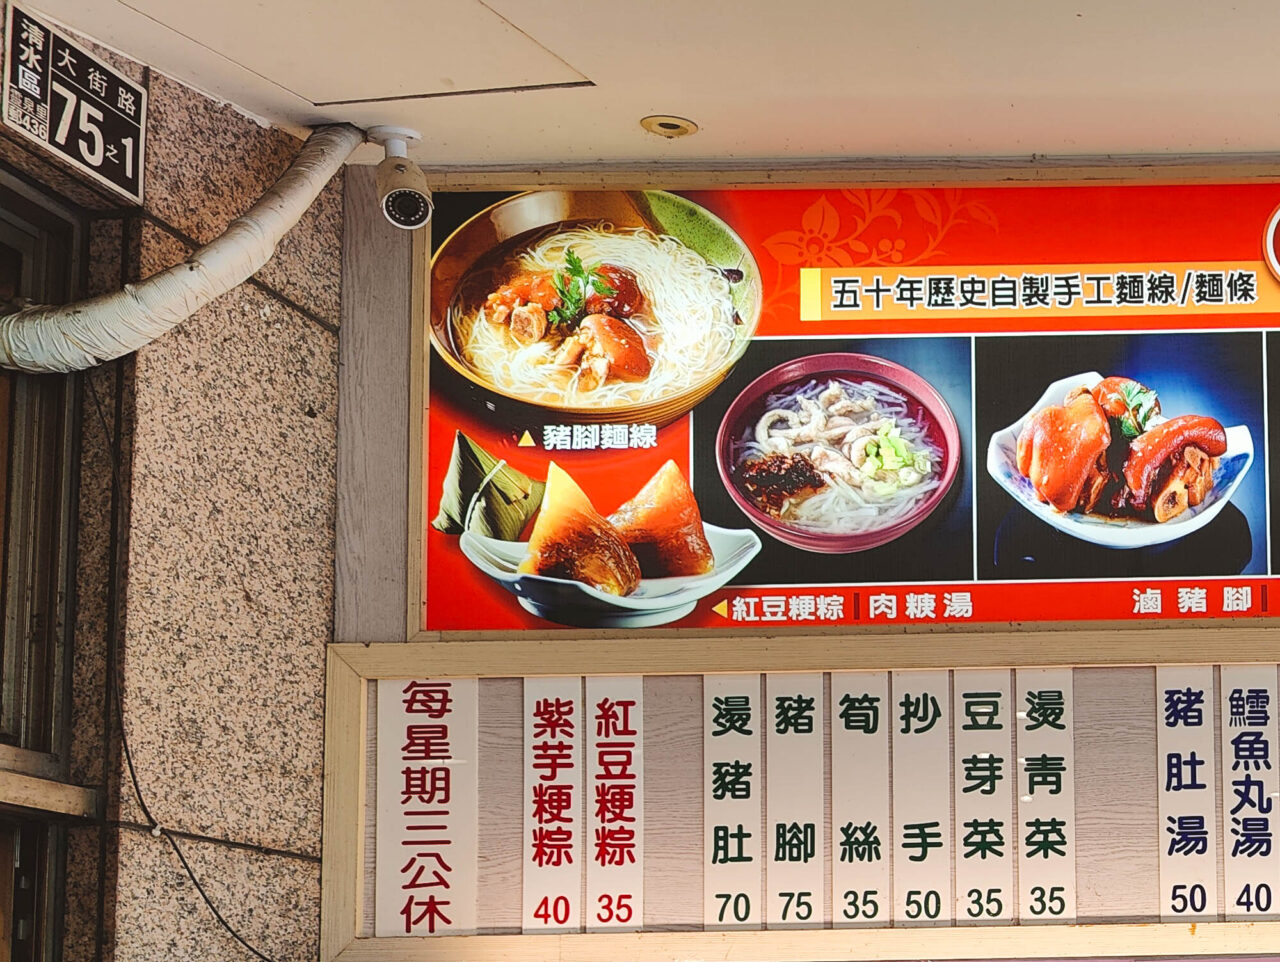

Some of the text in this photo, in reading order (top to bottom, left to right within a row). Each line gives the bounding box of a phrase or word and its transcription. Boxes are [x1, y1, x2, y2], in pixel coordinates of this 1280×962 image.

[18, 18, 45, 100] 清水區
[57, 48, 137, 117] 大街路
[830, 268, 1258, 312] 五十年歷史自製手工麵線/麵條
[542, 423, 658, 450] 豬腳麵線
[731, 595, 845, 622] 紅豆粳粽
[1132, 586, 1253, 614] 滷豬腳
[400, 680, 453, 934] 每星期三公休
[532, 697, 575, 925] 紫芋粳粽 40
[594, 697, 638, 923] 紅豆粳粽 35
[711, 695, 754, 922] 燙豬肚 70
[774, 694, 816, 921] 豬腳 75
[838, 692, 882, 919] 筍絲 35
[899, 692, 944, 919] 抄手 50
[961, 691, 1005, 918] 豆芽菜 35
[1028, 886, 1066, 916] 35
[1164, 687, 1209, 913] 豬肚湯 50
[1228, 688, 1273, 913] 鱈魚丸湯 40
